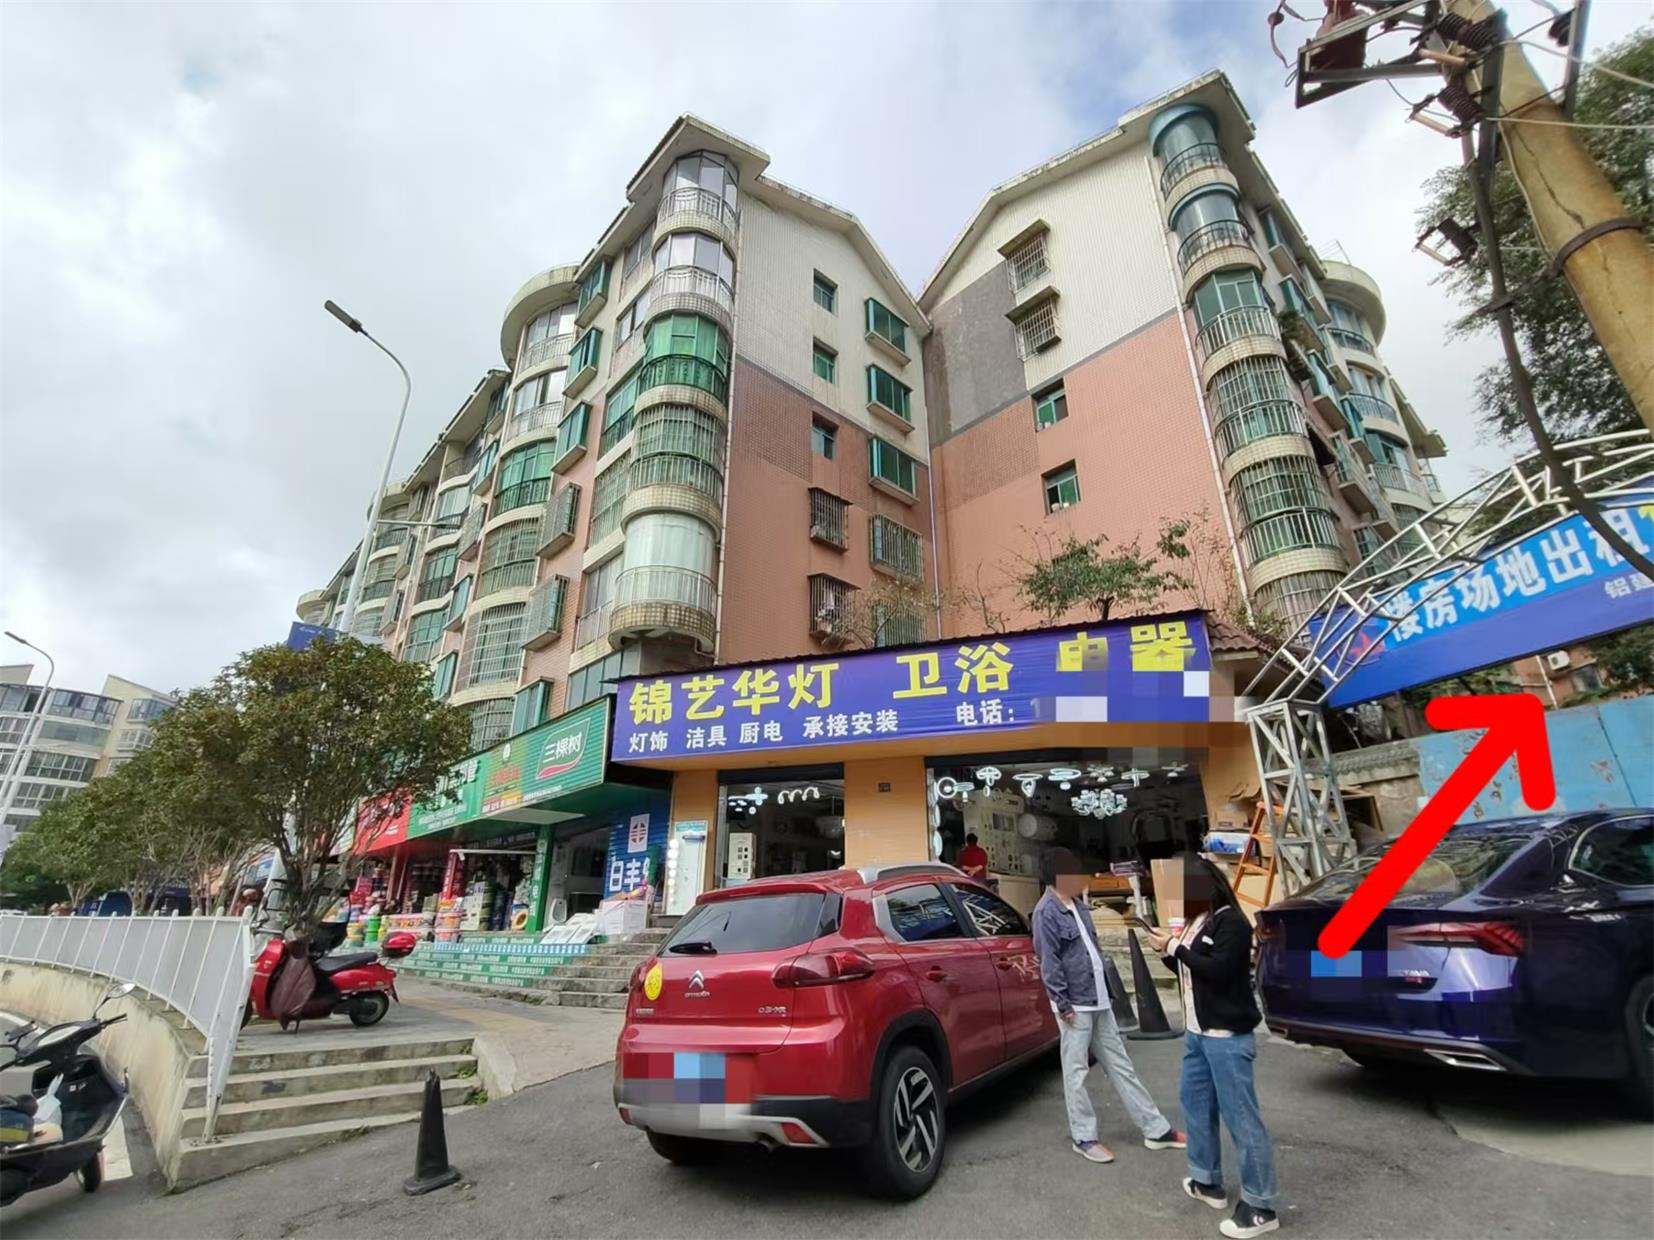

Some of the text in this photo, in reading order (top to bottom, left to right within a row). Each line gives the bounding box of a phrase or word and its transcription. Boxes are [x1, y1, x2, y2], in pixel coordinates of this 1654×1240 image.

[629, 663, 839, 725] 锦艺华灯
[893, 642, 1014, 699] 卫浴
[542, 732, 582, 764] 三棵树
[629, 730, 669, 753] 灯饰
[686, 725, 727, 749] 洁具
[739, 720, 783, 744] 厨电
[803, 709, 898, 739] 承接安装
